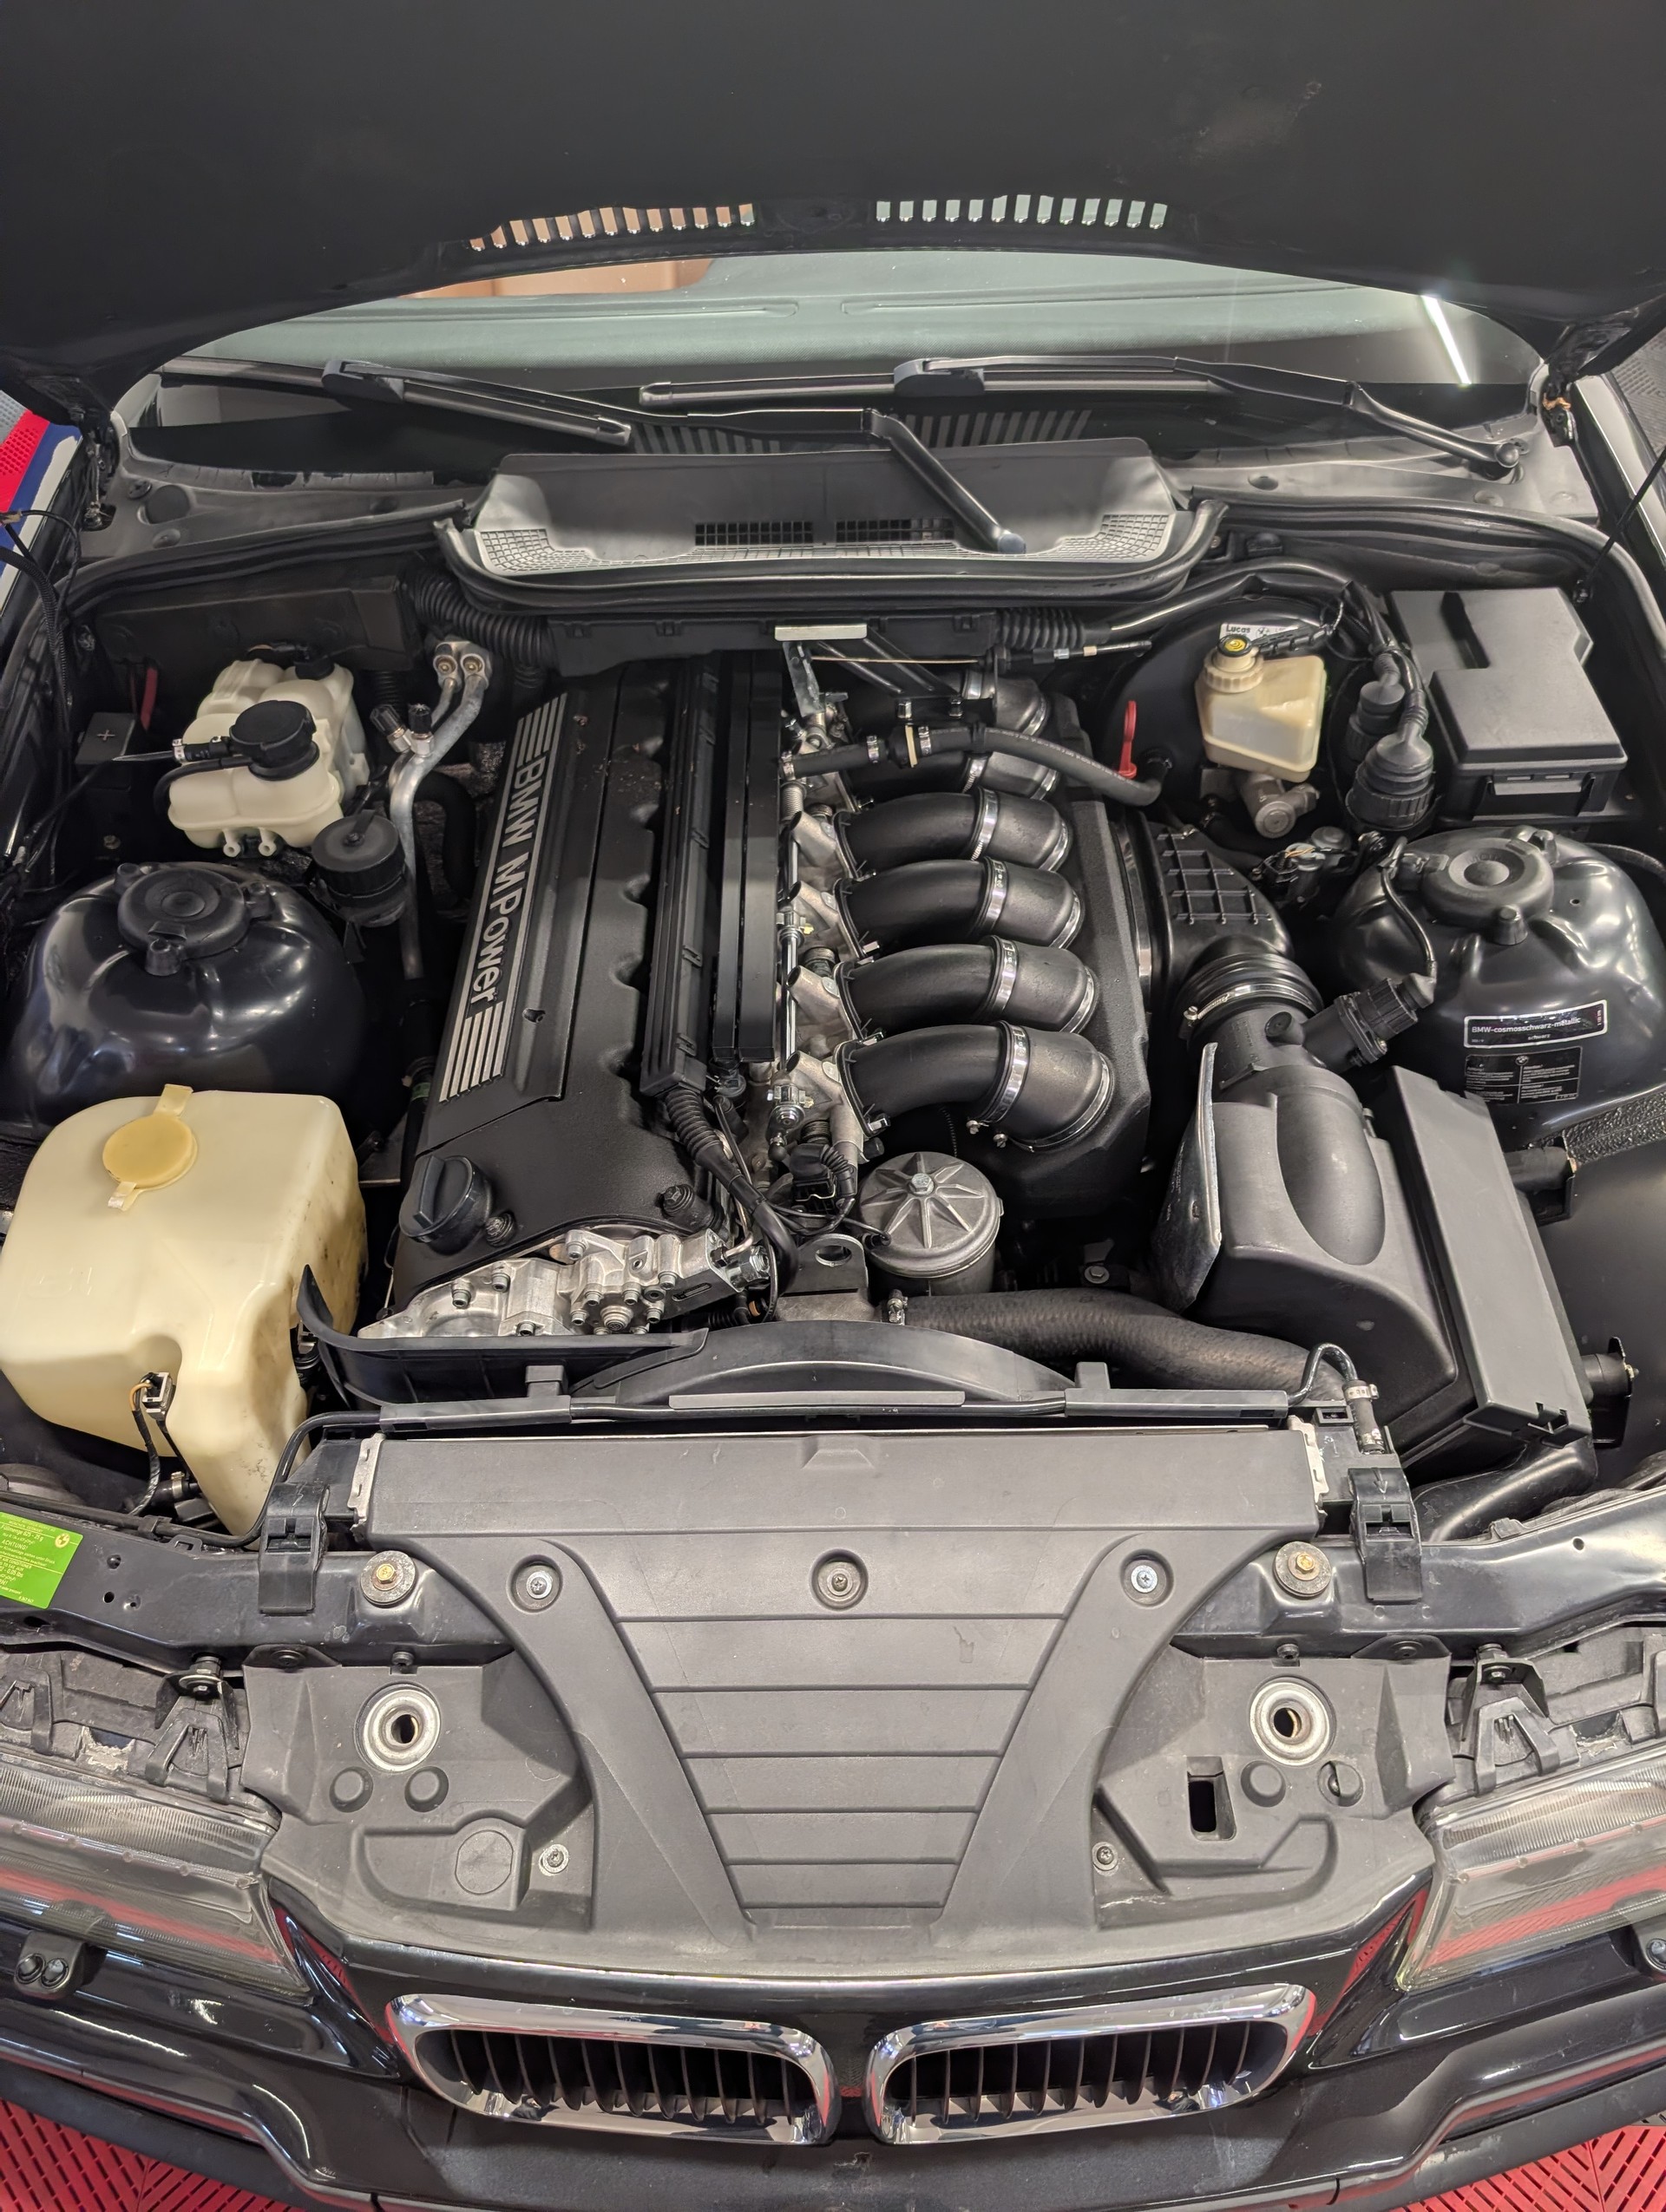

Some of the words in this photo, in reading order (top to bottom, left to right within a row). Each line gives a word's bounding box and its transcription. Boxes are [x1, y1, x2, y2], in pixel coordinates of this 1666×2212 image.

[1226, 624, 1250, 633] Lucas
[502, 761, 546, 847] BMW
[2, 1539, 29, 1550] ACHTUNG!
